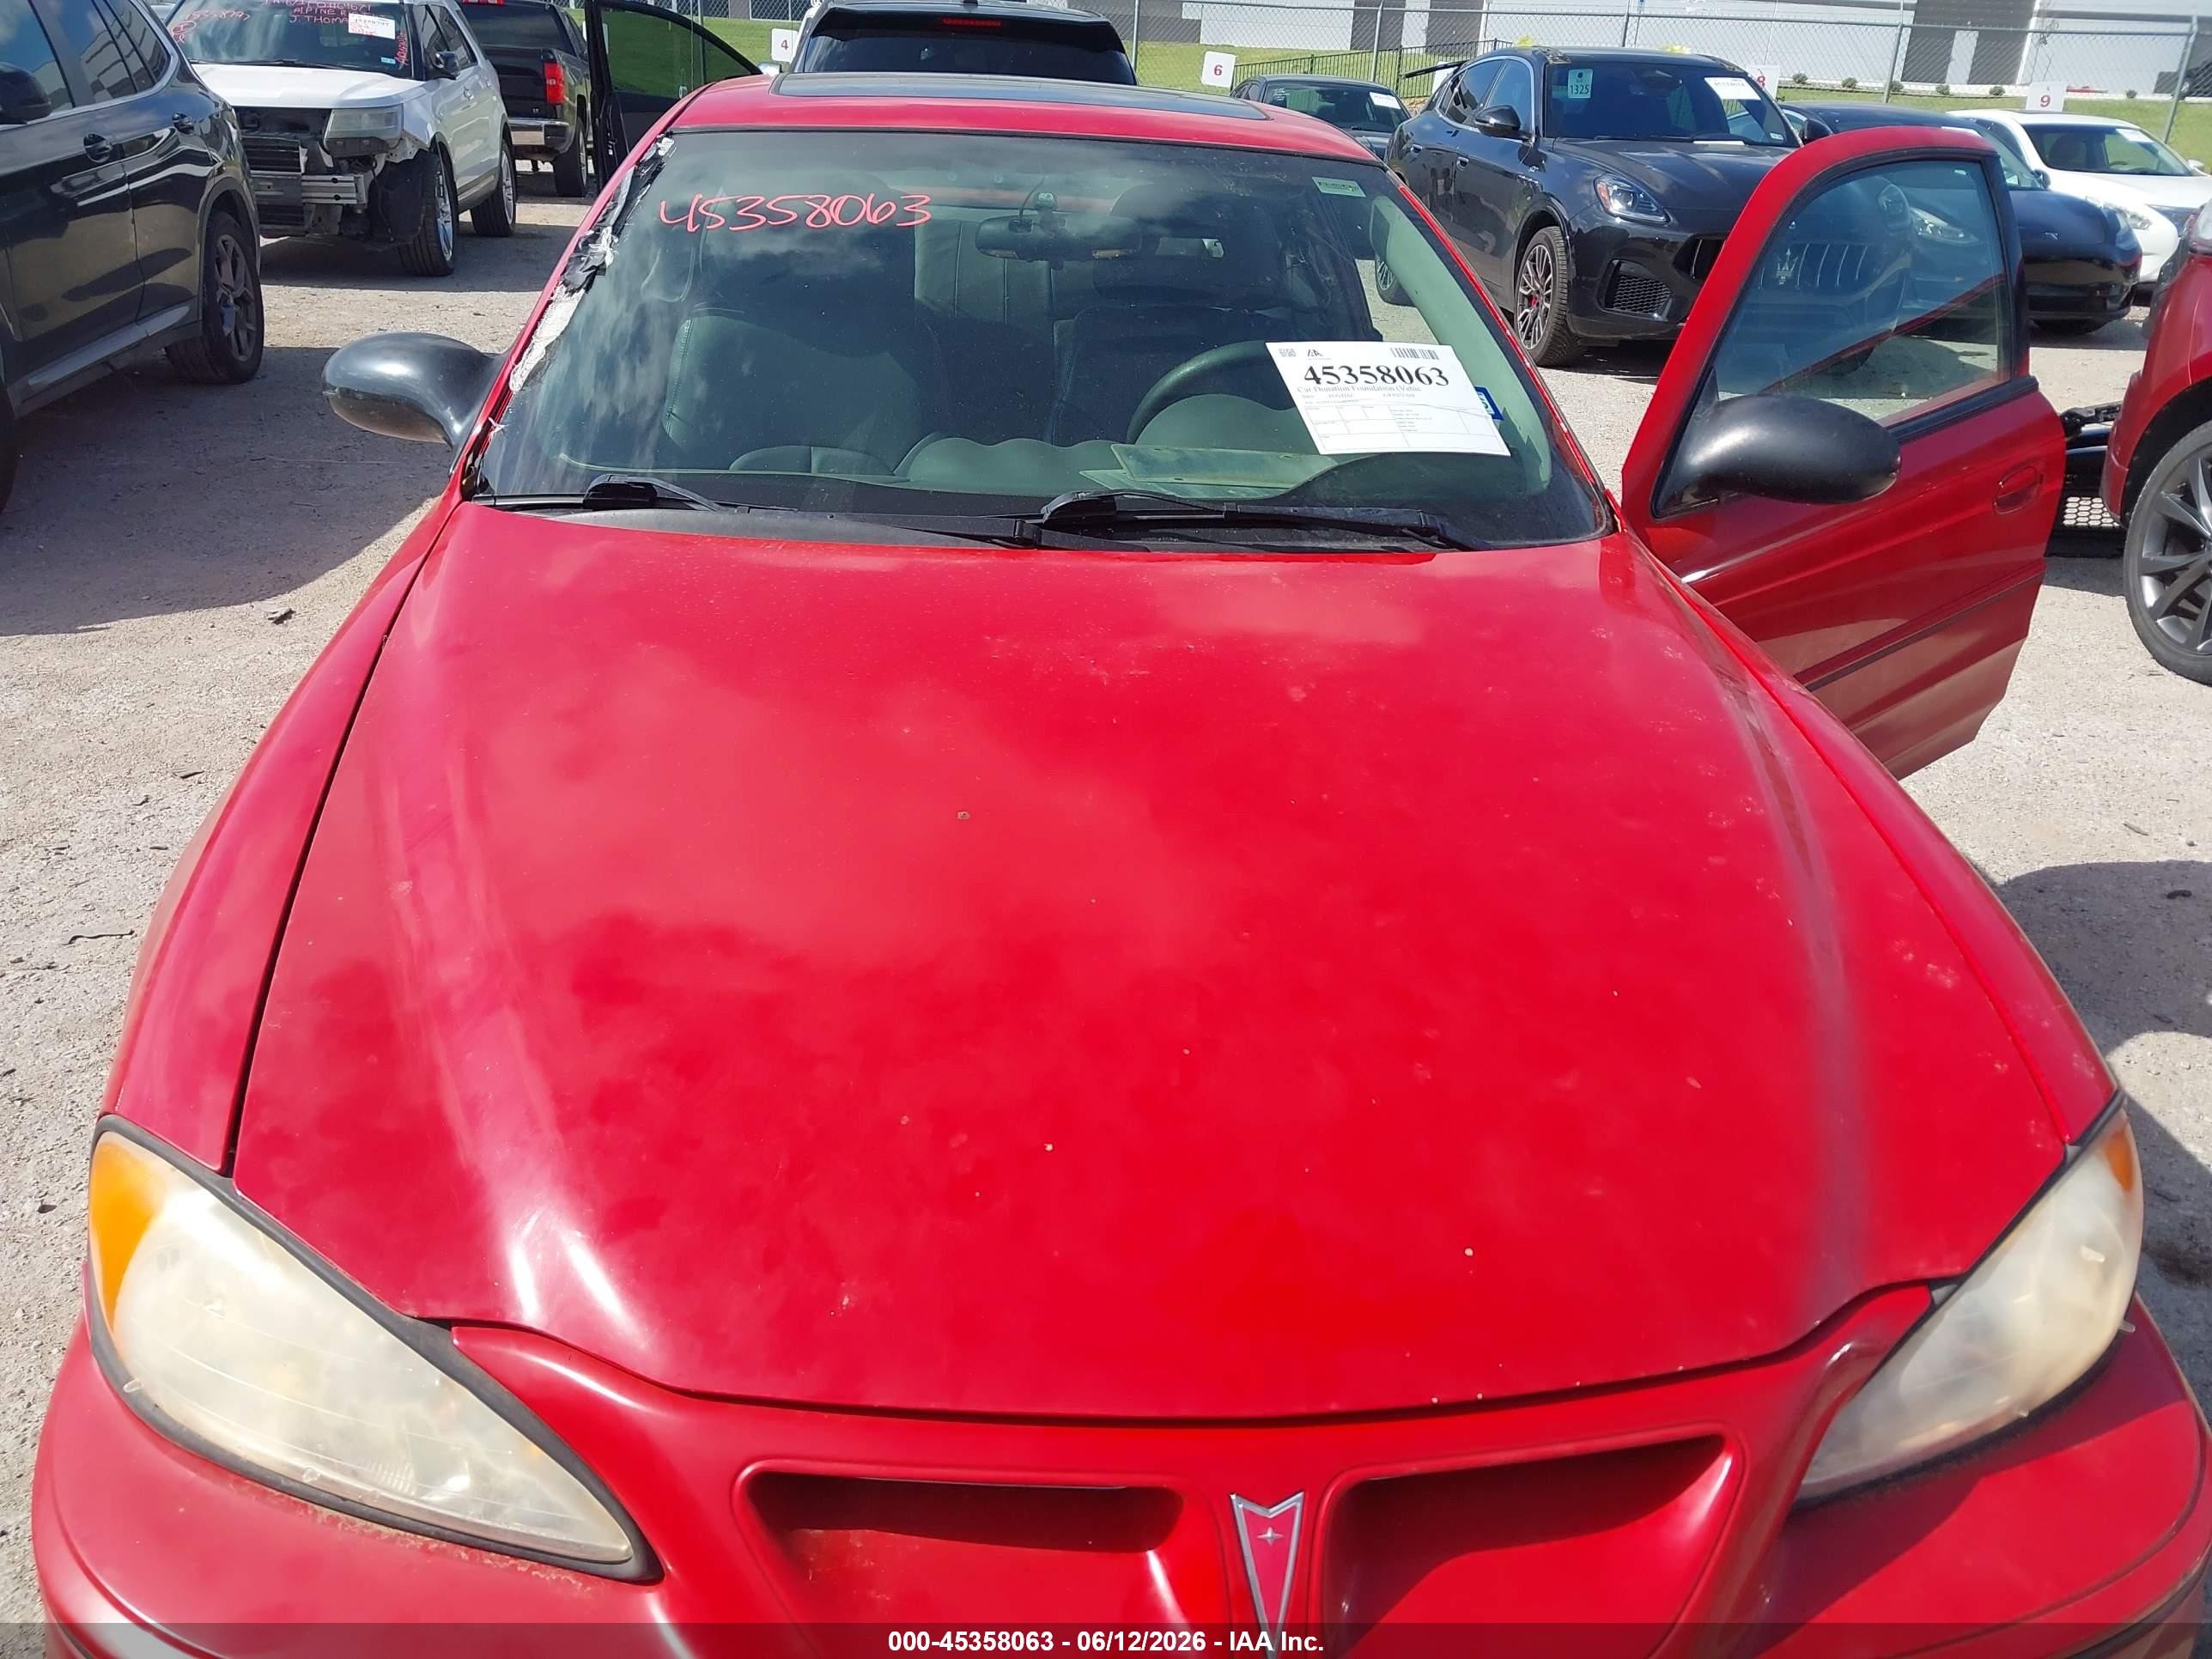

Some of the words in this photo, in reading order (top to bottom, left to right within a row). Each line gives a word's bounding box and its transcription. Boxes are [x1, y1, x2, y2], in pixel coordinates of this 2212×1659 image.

[307, 15, 349, 24] THOMA
[781, 40, 789, 50] 4
[1214, 64, 1223, 76] 6
[1570, 84, 1589, 94] 1325
[2039, 94, 2051, 107] 9
[659, 193, 932, 232] 45358063
[1303, 365, 1449, 386] 45358063
